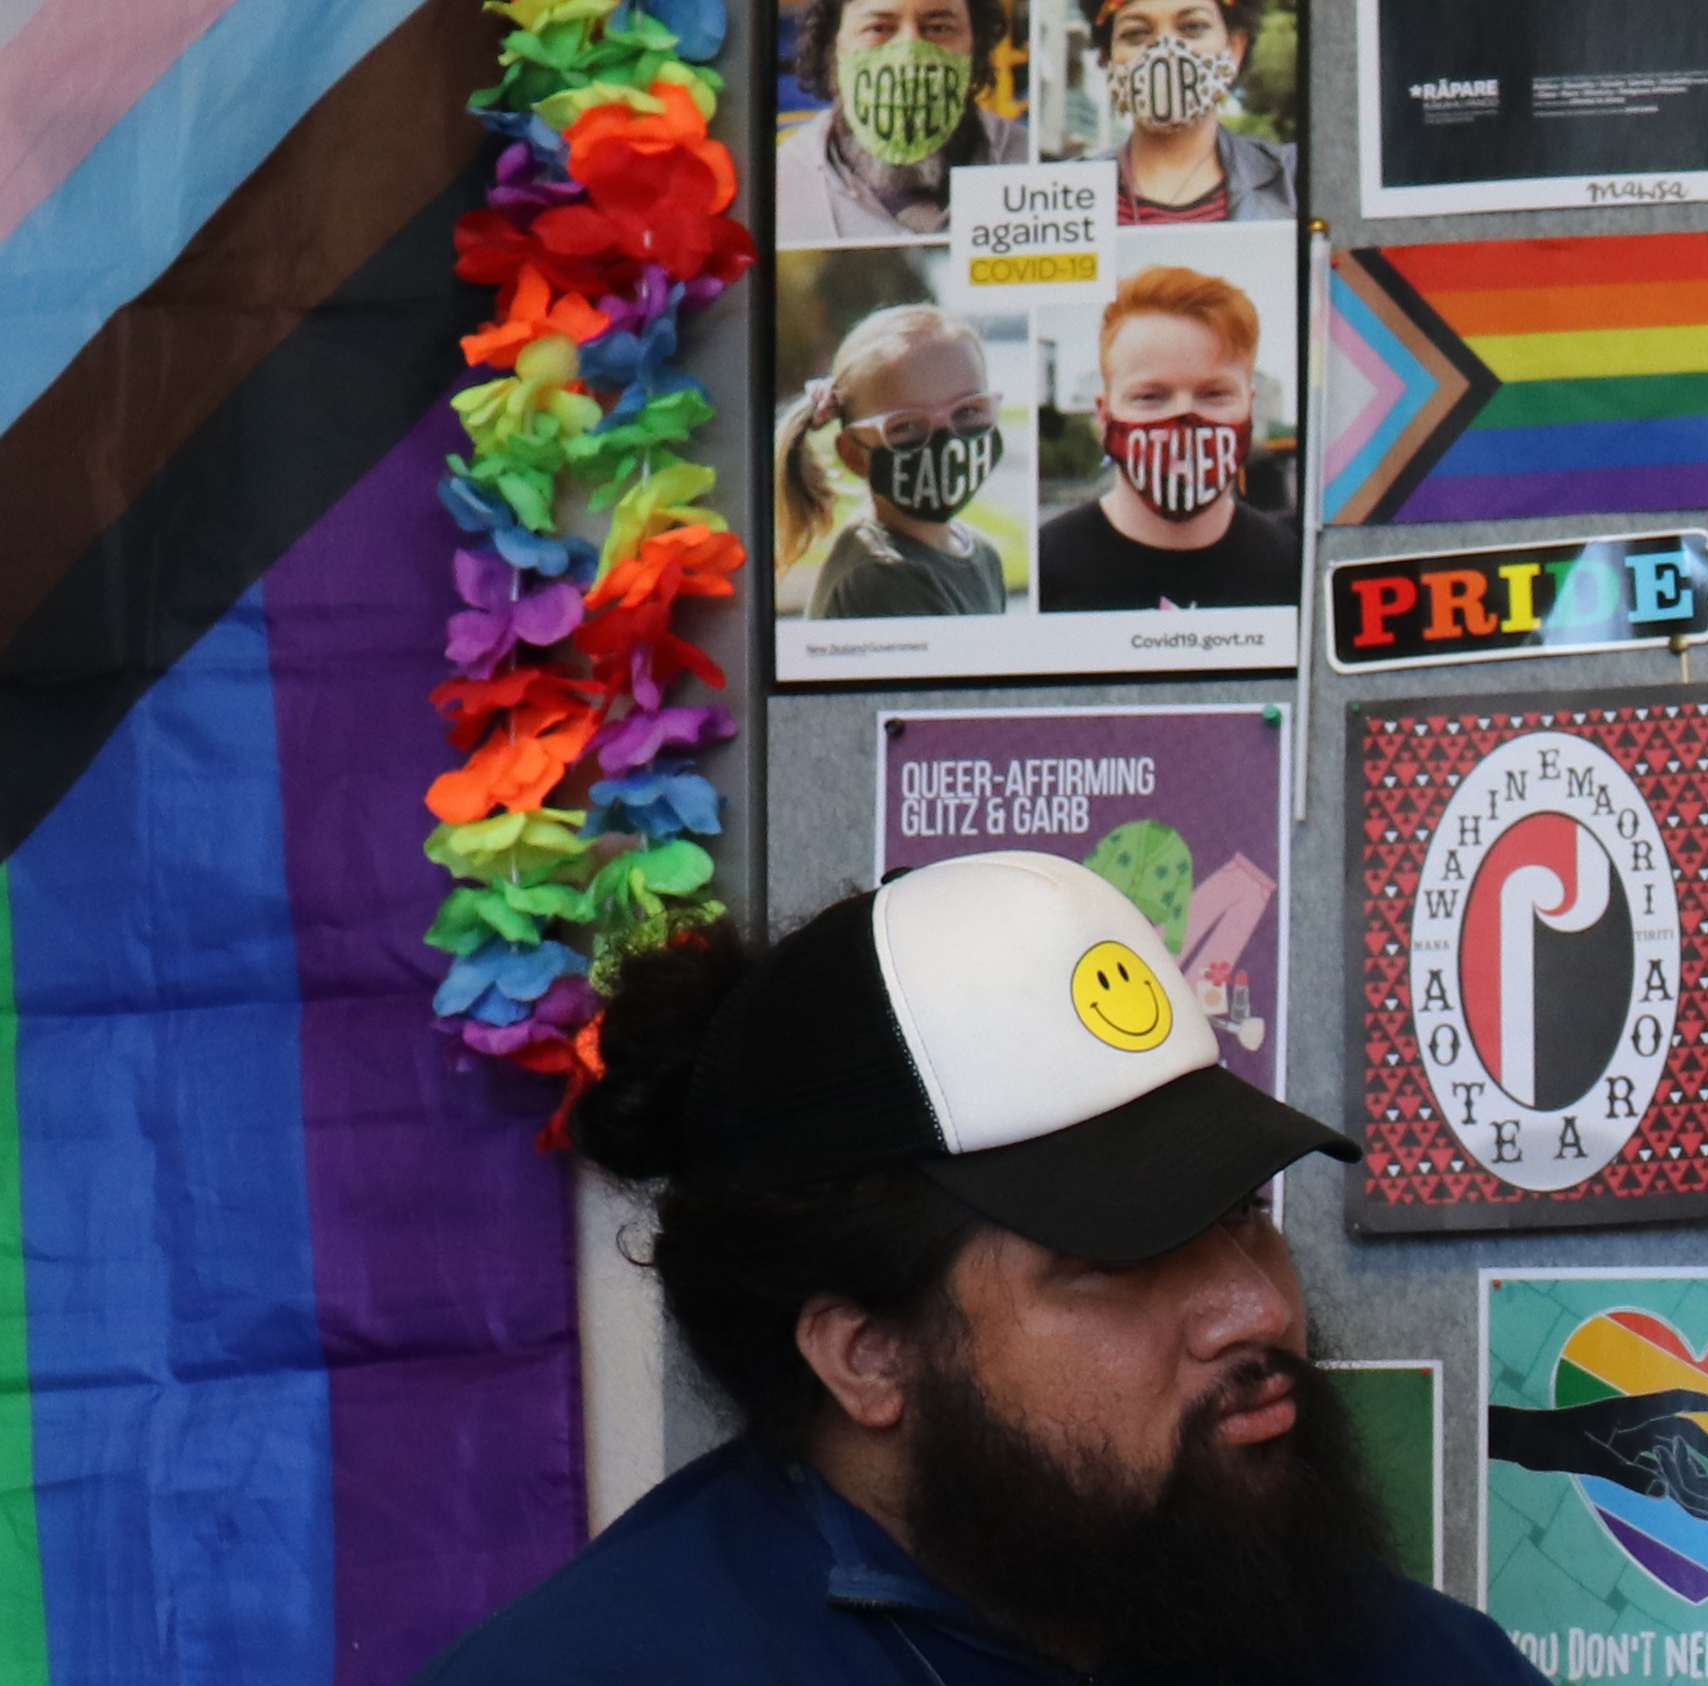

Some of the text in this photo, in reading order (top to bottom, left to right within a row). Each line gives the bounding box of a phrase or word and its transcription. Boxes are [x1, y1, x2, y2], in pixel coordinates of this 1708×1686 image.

[853, 61, 963, 146] COVER
[1130, 54, 1199, 123] FOR
[1003, 184, 1094, 211] Unite
[971, 213, 1094, 253] against
[971, 256, 1097, 284] COVID-19
[893, 430, 991, 507] EACH
[1127, 427, 1238, 513] OTHER
[1351, 551, 1694, 647] PRIDE
[1131, 632, 1265, 655] Covid19.govt.nz
[901, 758, 1155, 801] QUEER-AFFIRMING
[901, 797, 1089, 836] GLITZ & GARB
[1413, 939, 1451, 951] MANA
[1568, 1627, 1656, 1680] DON'T
